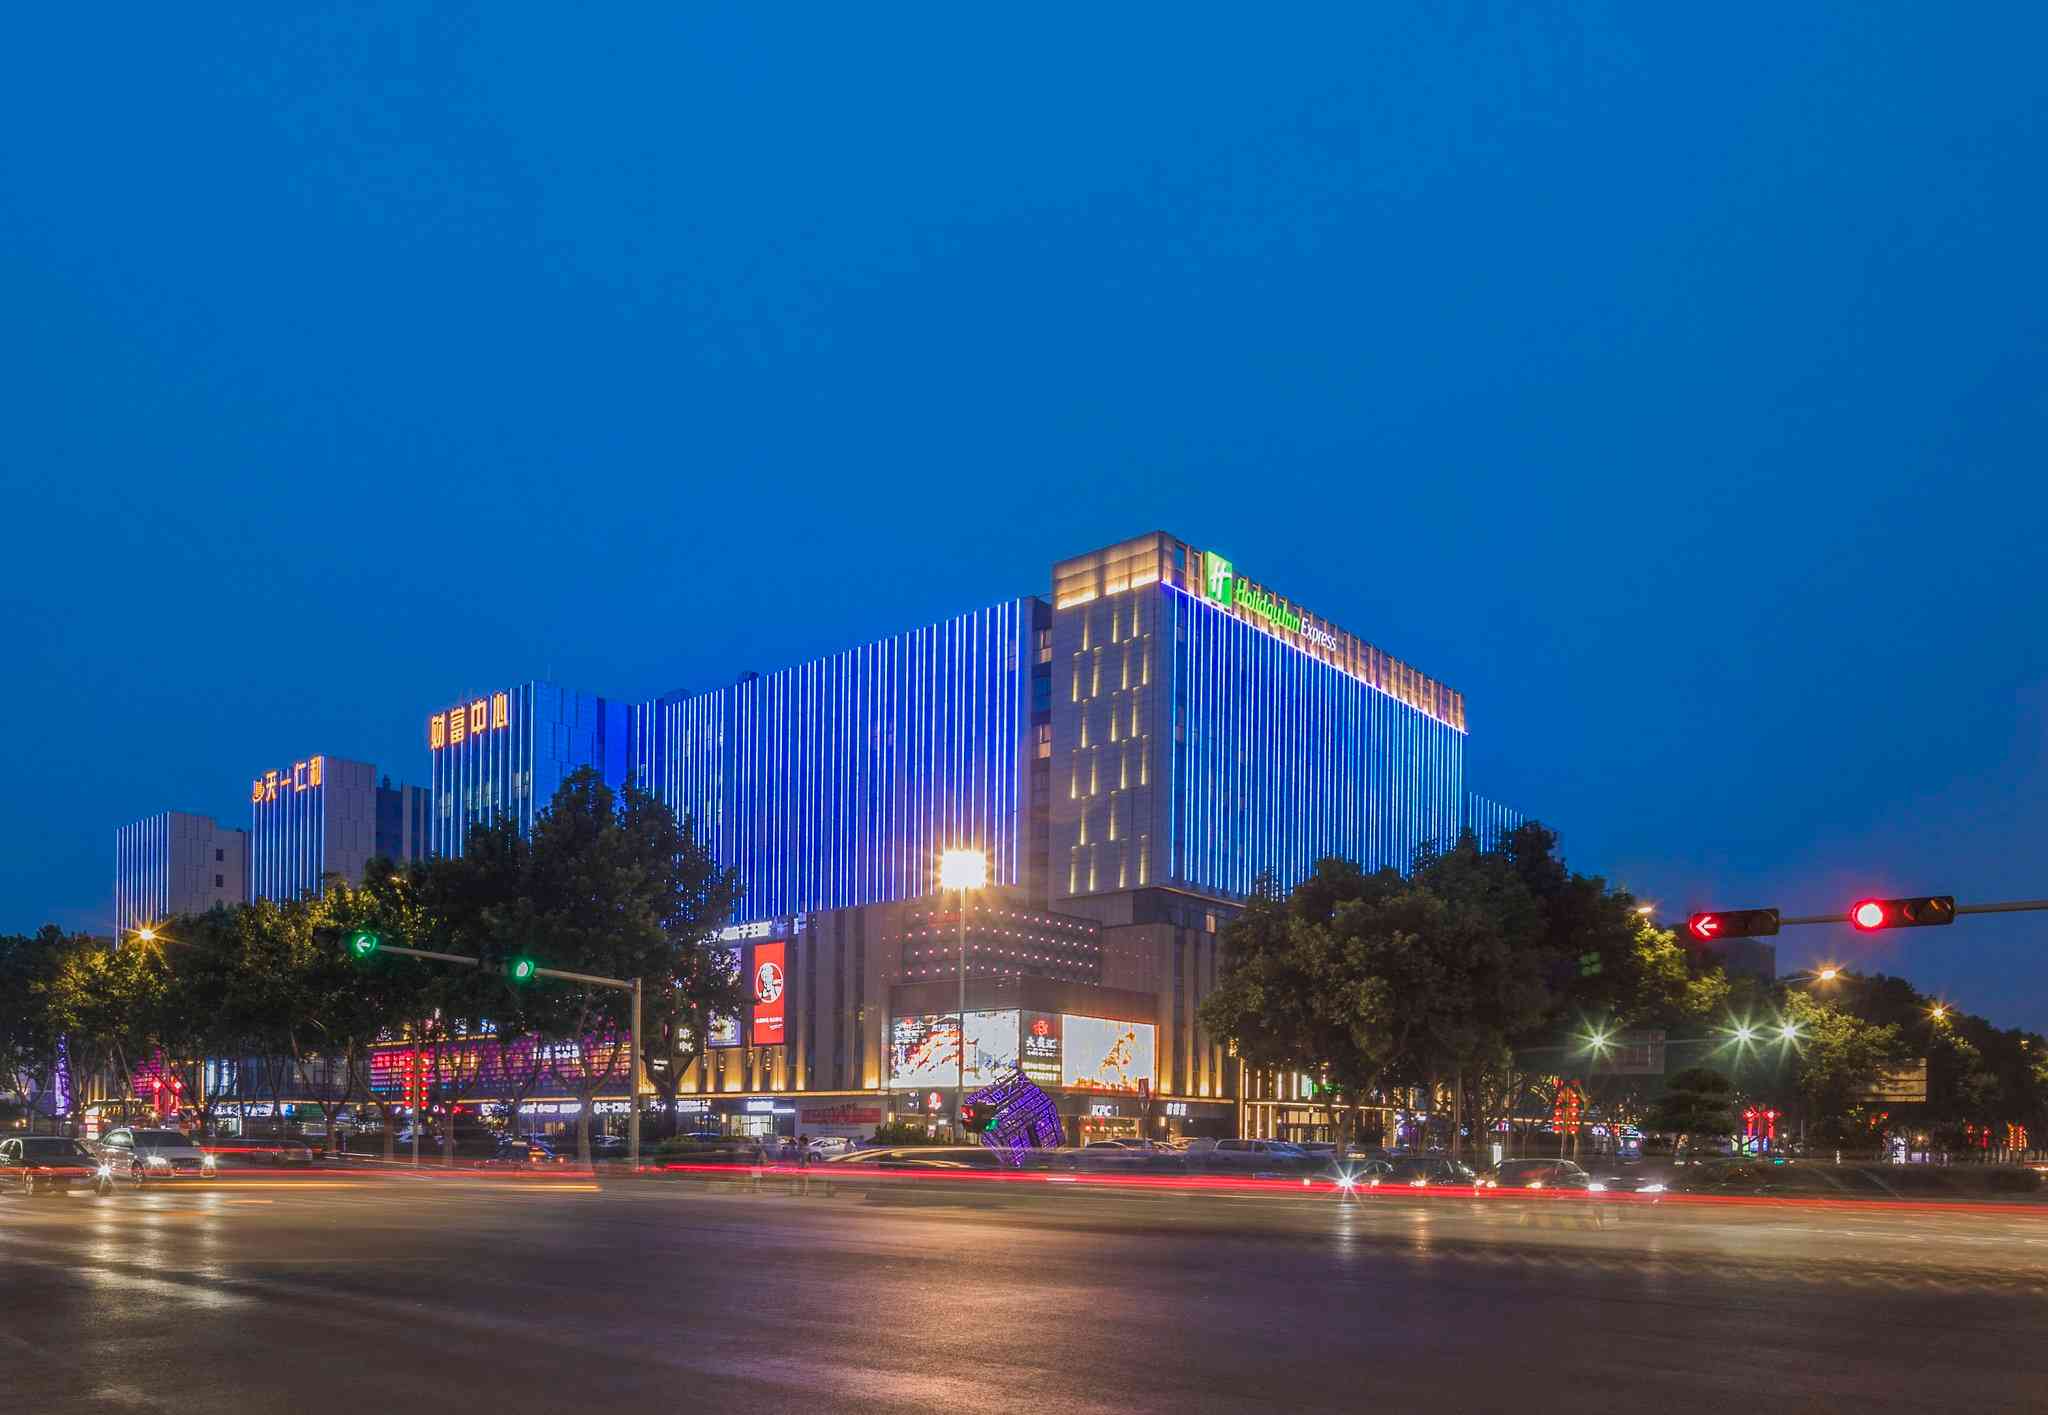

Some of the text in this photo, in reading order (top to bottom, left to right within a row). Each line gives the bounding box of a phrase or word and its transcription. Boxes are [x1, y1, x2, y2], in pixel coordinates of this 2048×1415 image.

[1235, 579, 1280, 627] Holiday
[1301, 617, 1337, 652] Express
[431, 692, 509, 750] 财富中心
